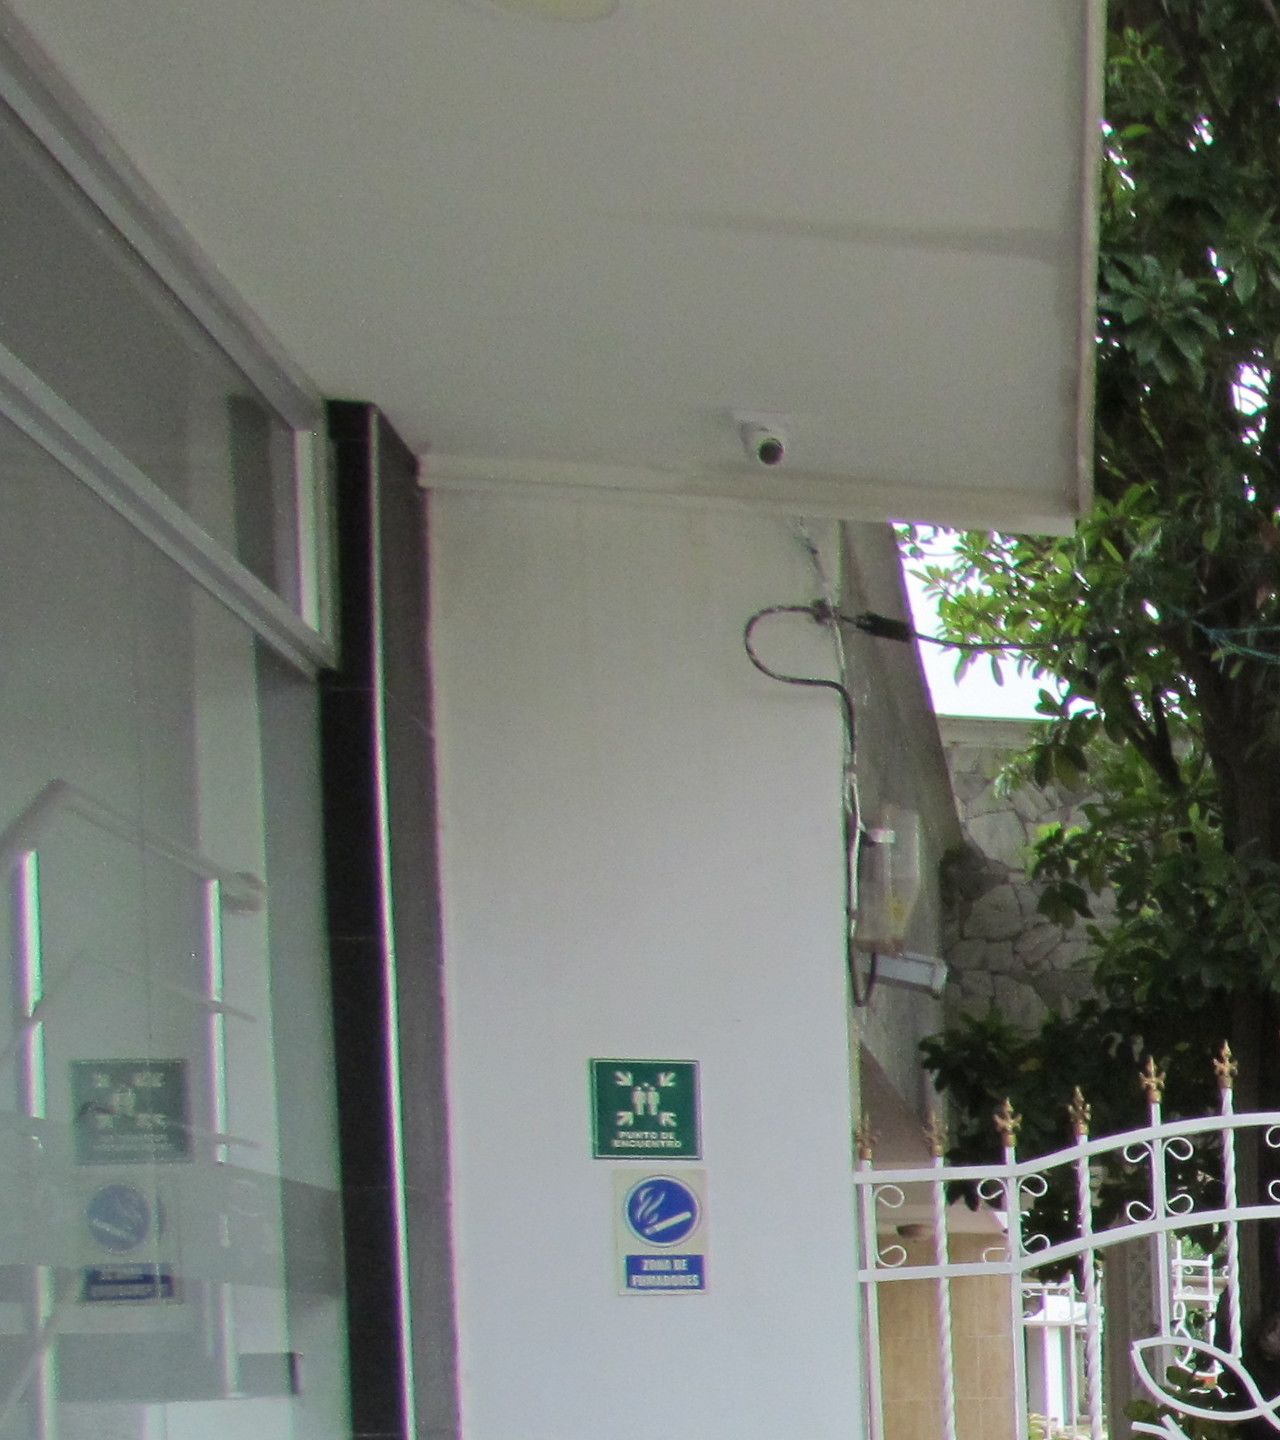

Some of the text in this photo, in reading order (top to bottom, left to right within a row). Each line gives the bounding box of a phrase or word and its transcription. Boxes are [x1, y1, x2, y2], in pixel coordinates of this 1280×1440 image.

[618, 1131, 675, 1139] PUNTO DE
[613, 1140, 682, 1148] ENCUENTRO
[674, 1259, 688, 1271] DE
[631, 1275, 700, 1287] FUMADORES
